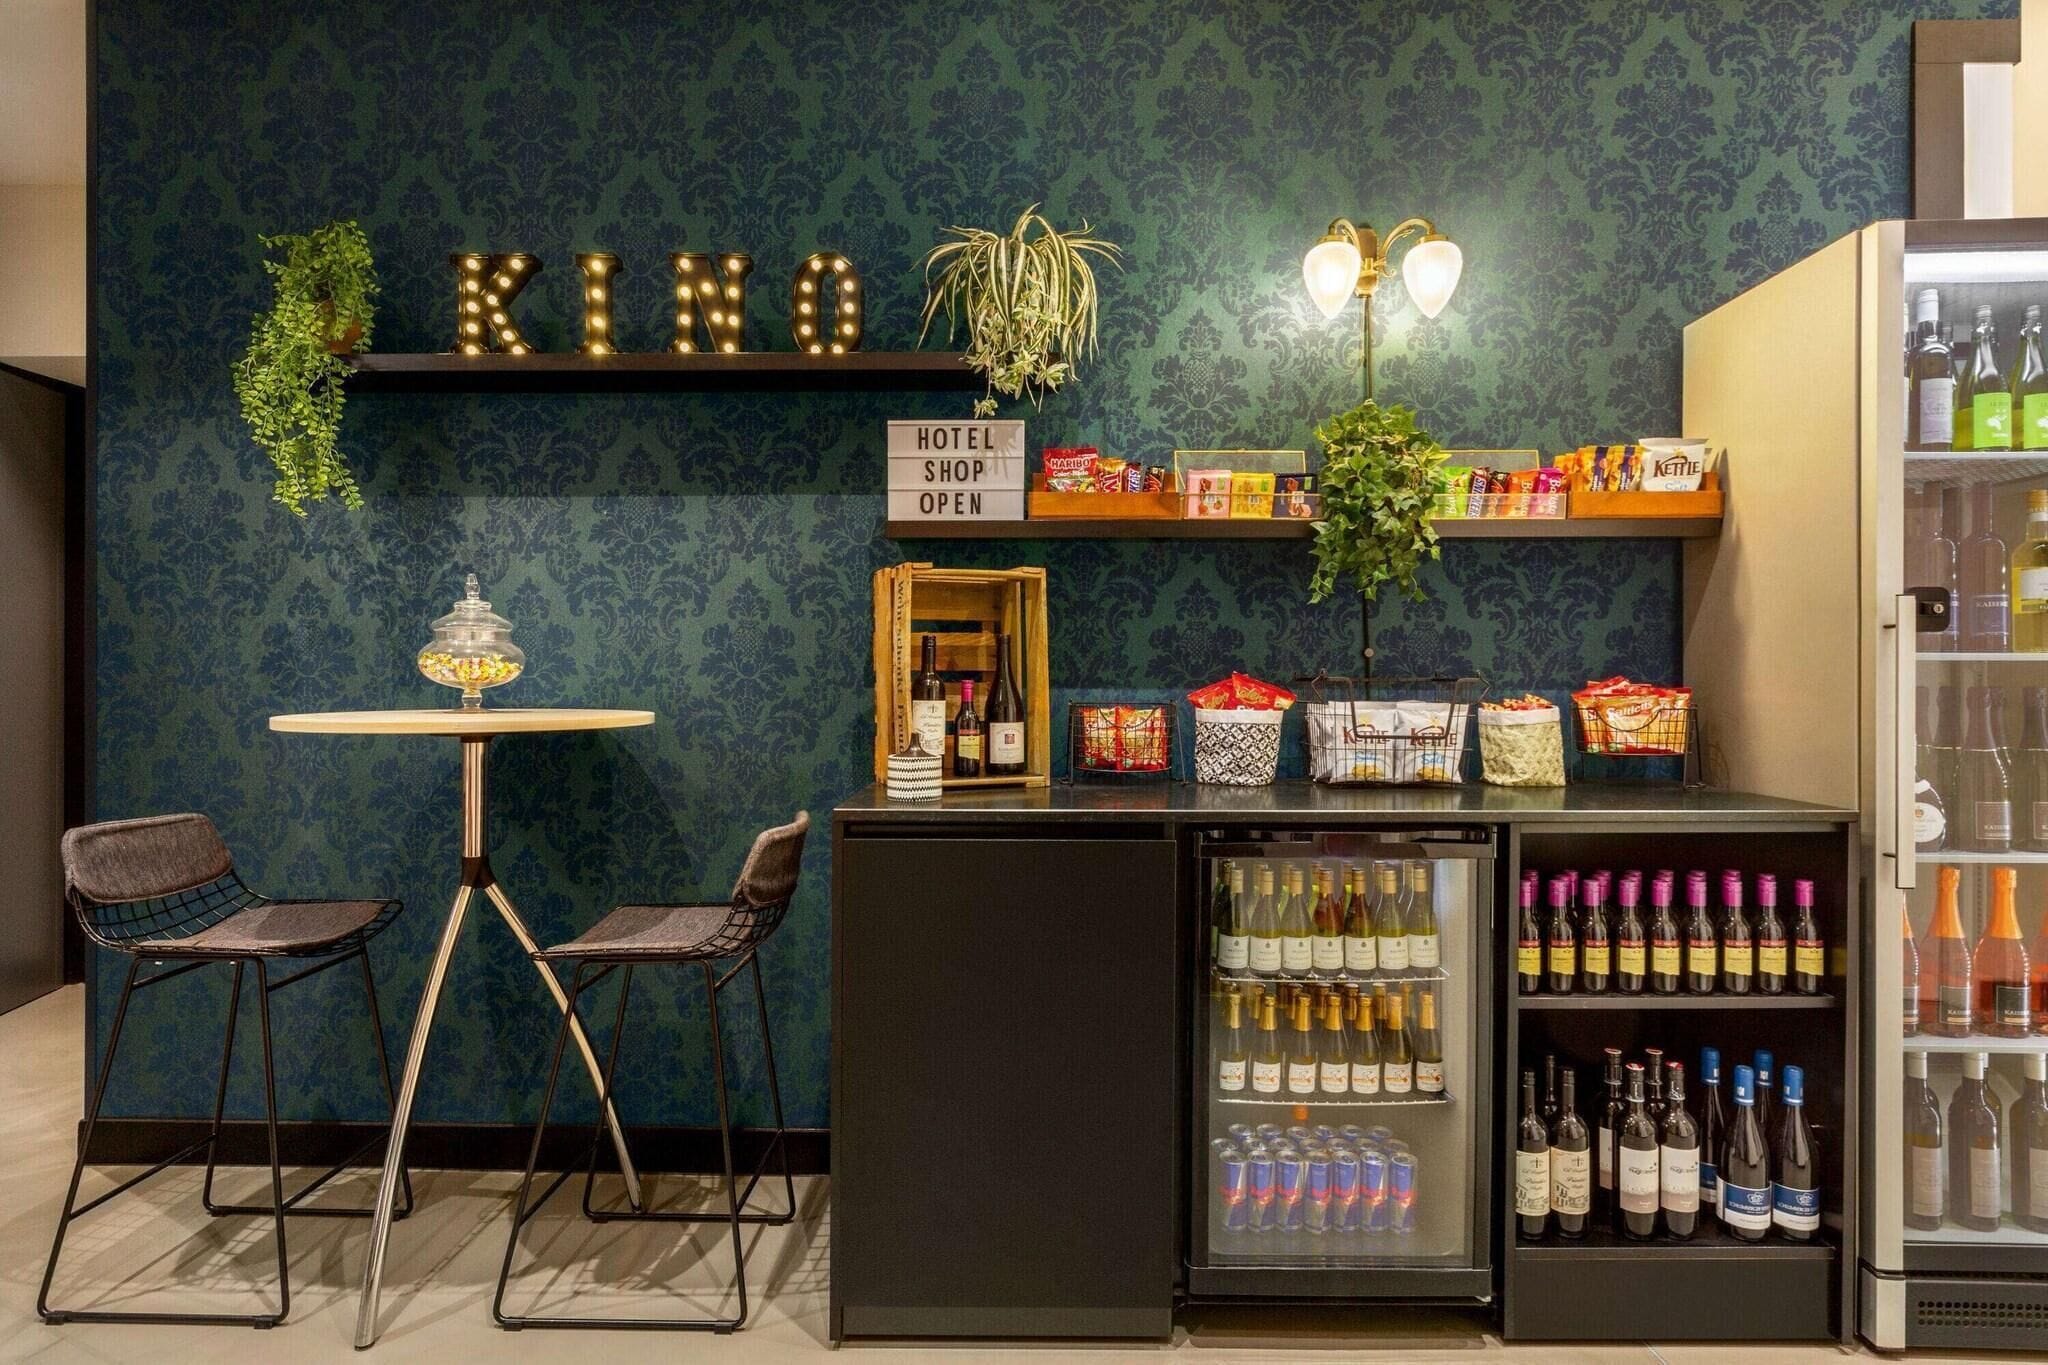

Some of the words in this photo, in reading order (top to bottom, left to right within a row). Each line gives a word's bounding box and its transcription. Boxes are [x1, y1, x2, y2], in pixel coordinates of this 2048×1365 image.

[451, 252, 865, 354] KINO
[918, 427, 994, 450] HOTEL
[925, 460, 984, 482] SHOP
[1050, 458, 1090, 469] HARIBO
[1654, 457, 1701, 477] KETTLE
[919, 492, 981, 515] OPEN
